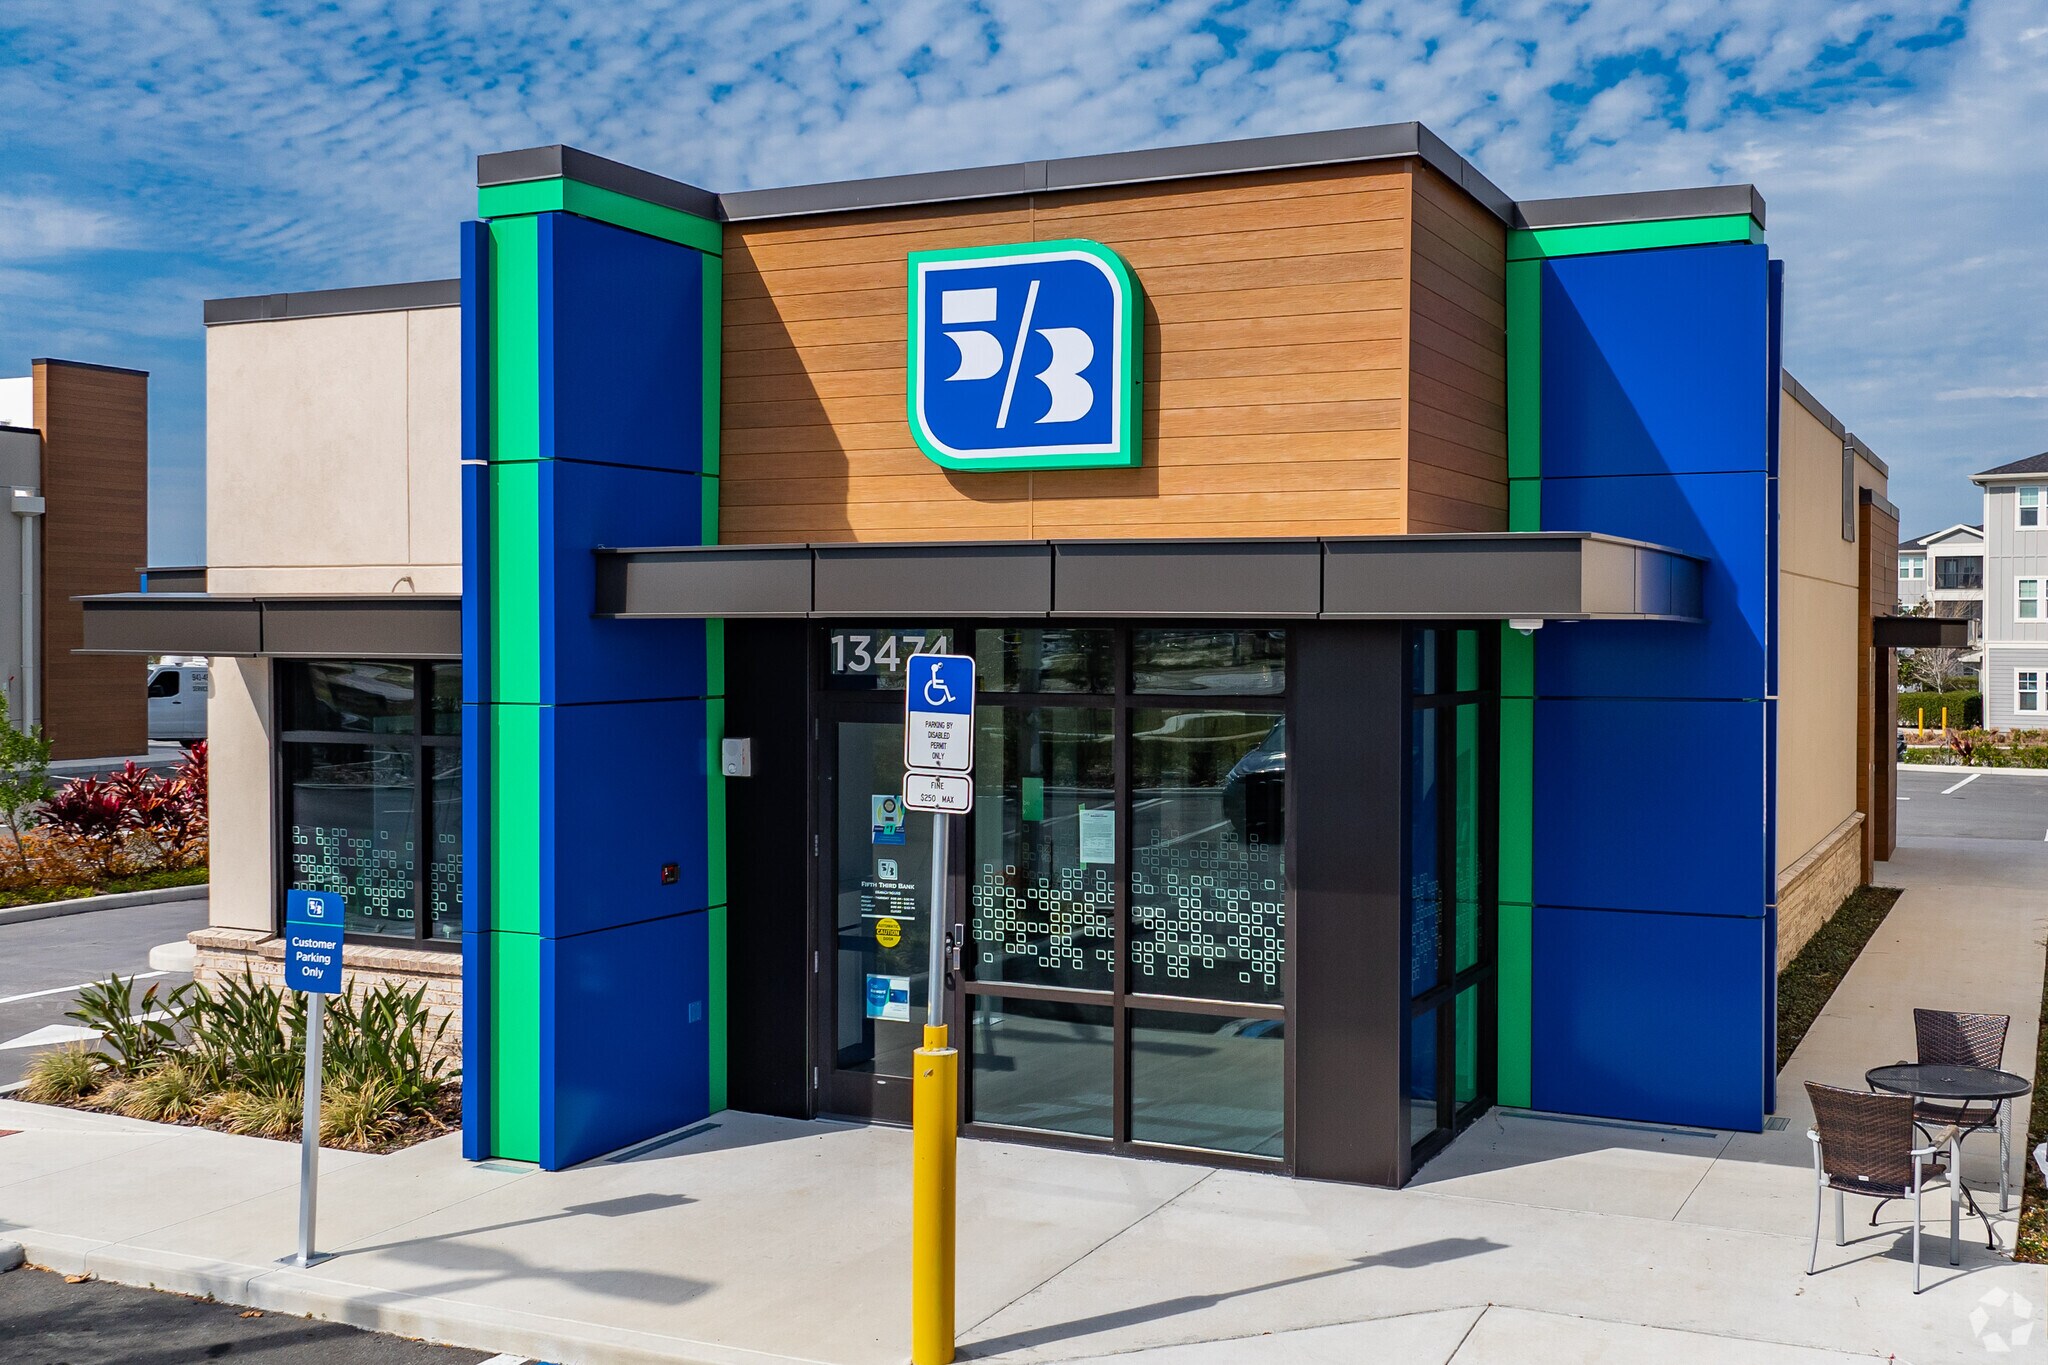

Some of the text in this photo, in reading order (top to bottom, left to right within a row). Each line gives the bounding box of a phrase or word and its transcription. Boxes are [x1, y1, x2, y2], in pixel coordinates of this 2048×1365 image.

[925, 720, 945, 729] PARKING
[928, 731, 950, 739] DISABLED
[930, 741, 947, 749] PERMIT
[932, 752, 945, 760] ONLY
[930, 781, 944, 790] FINE
[920, 793, 954, 803] $250 MAX
[292, 936, 336, 950] Customer
[296, 951, 331, 965] Parking
[302, 966, 324, 979] Only
